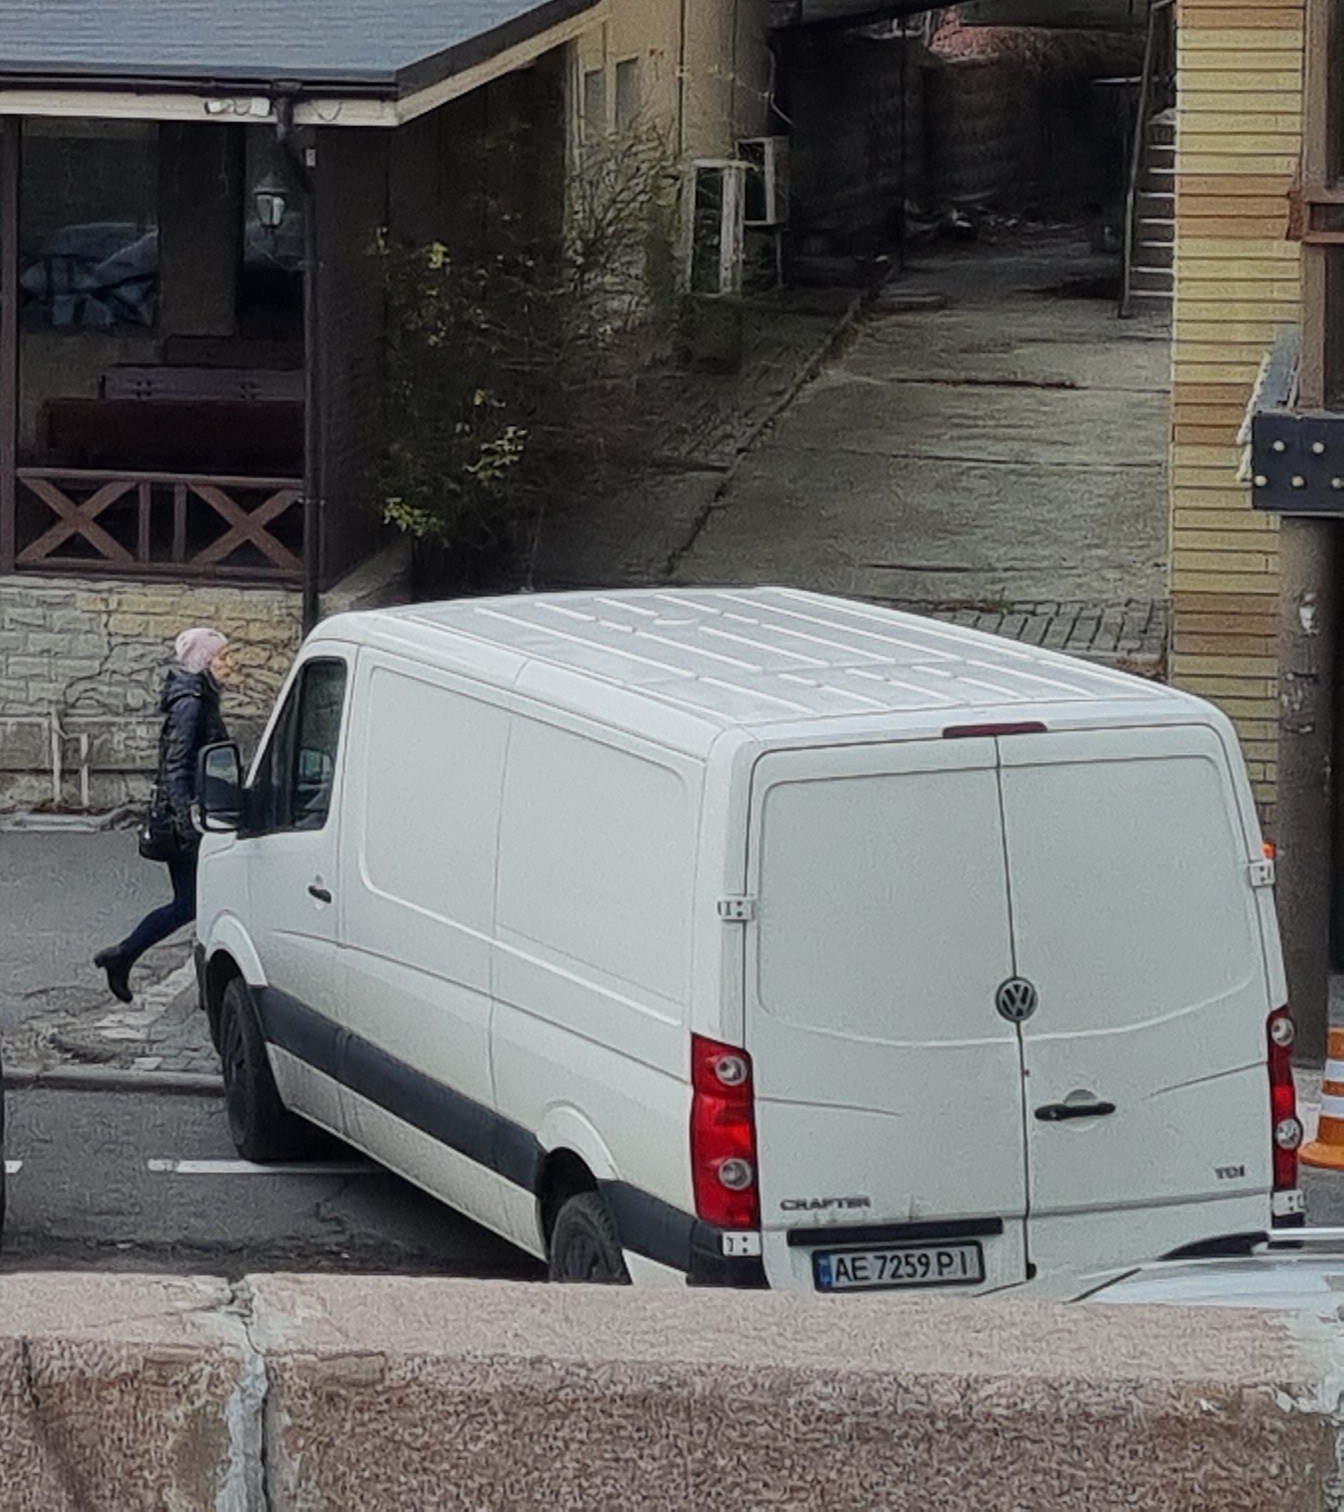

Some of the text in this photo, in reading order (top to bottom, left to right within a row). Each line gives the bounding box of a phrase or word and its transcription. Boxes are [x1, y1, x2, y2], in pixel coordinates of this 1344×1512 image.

[779, 1195, 872, 1211] CRAFTER
[834, 1250, 969, 1283] AE 7259 PI
